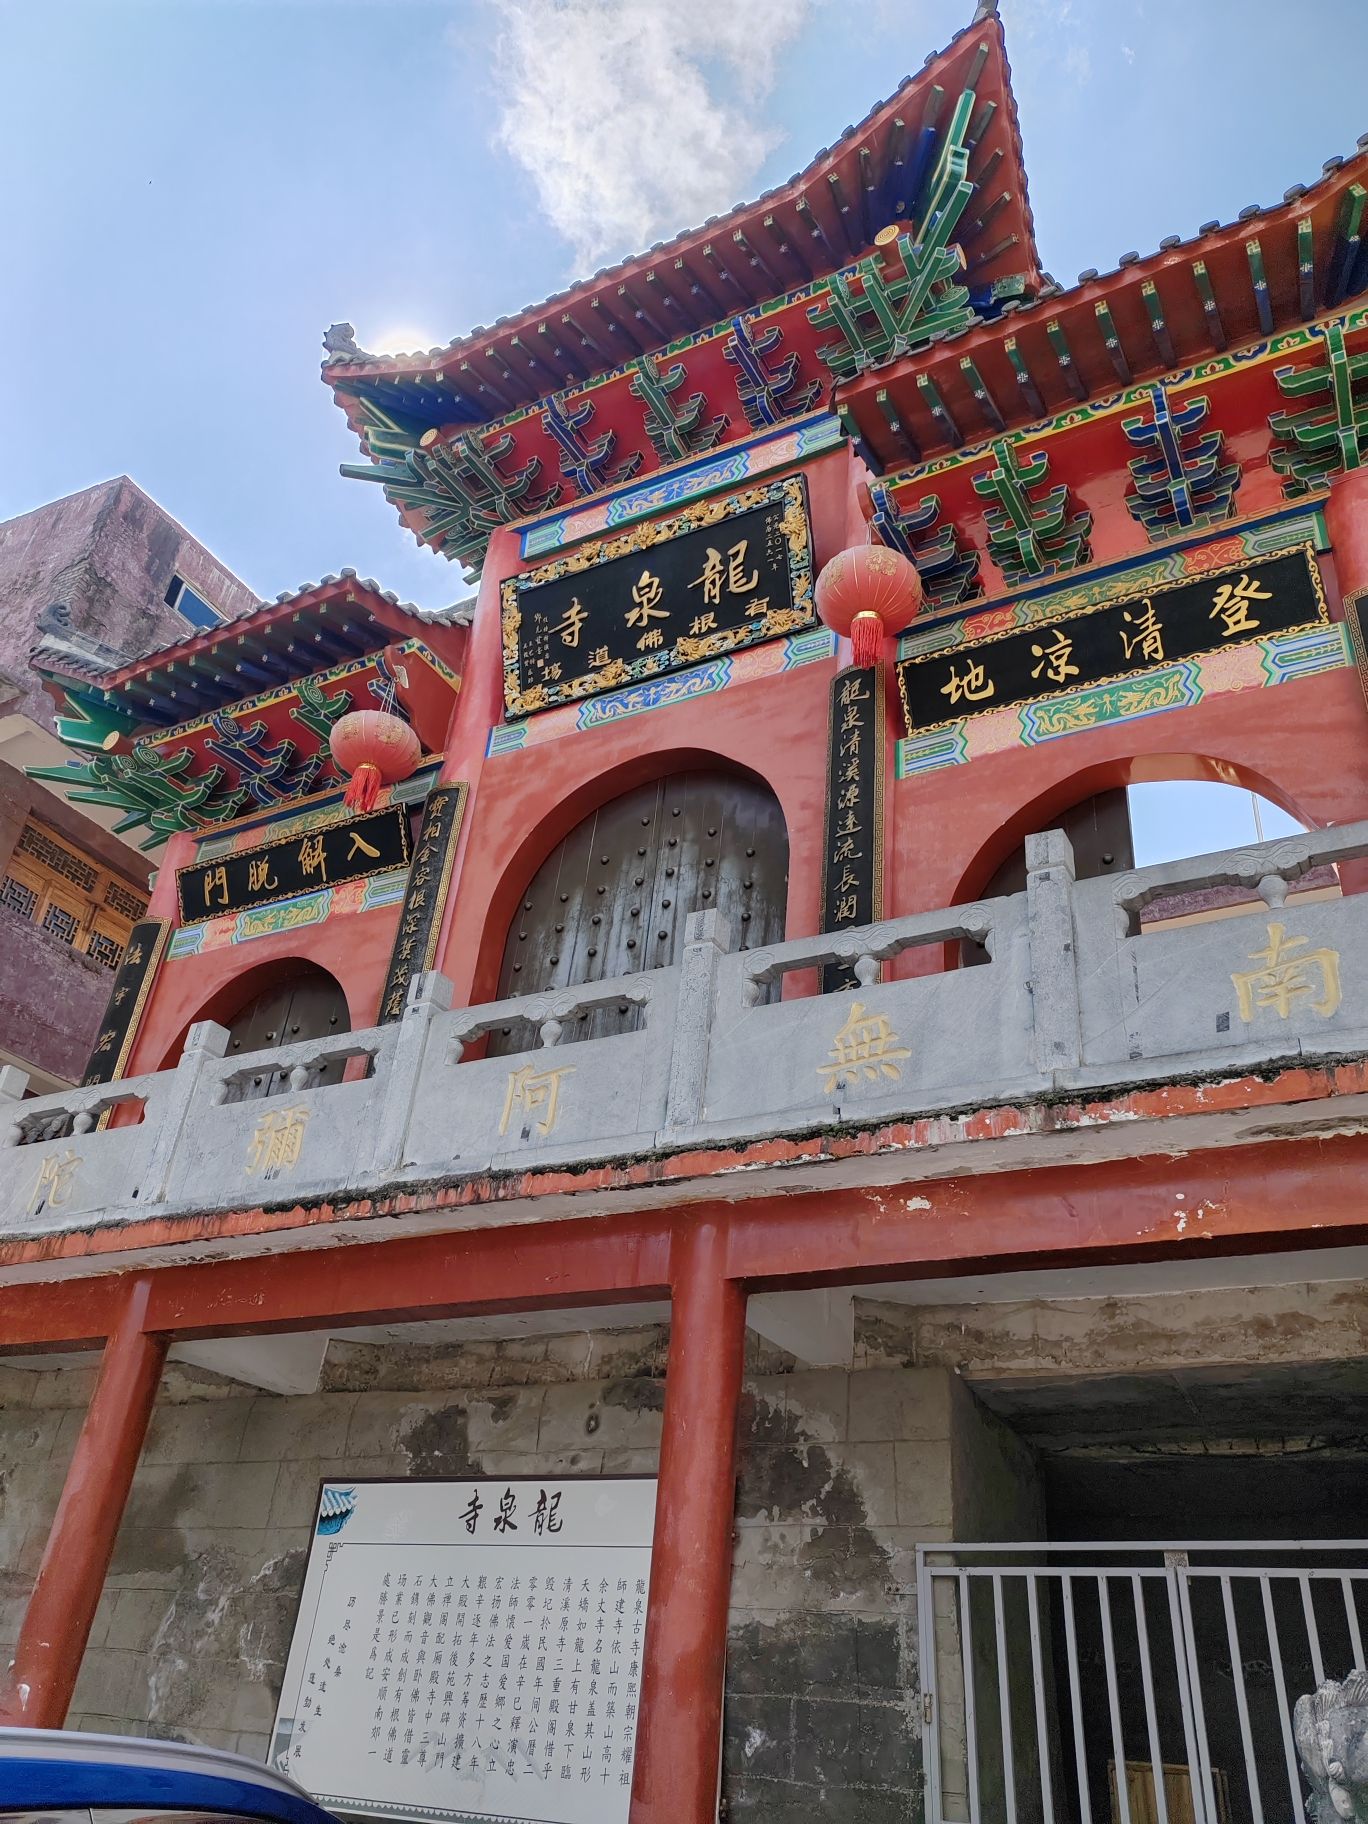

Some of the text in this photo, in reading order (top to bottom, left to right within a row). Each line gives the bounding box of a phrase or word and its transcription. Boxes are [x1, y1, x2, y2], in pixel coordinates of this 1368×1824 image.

[549, 539, 759, 648] 龍泉寺
[832, 678, 870, 993] 龍泉清溪源遠流長潤一
[384, 796, 449, 1024] 寶相金容根深葉茂蔭
[1230, 922, 1342, 1023] 南
[817, 1002, 912, 1093] 無
[245, 1103, 311, 1175] 彌
[500, 1064, 577, 1137] 阿
[27, 1150, 84, 1213] 陀
[458, 1487, 563, 1535] 龍泉寺
